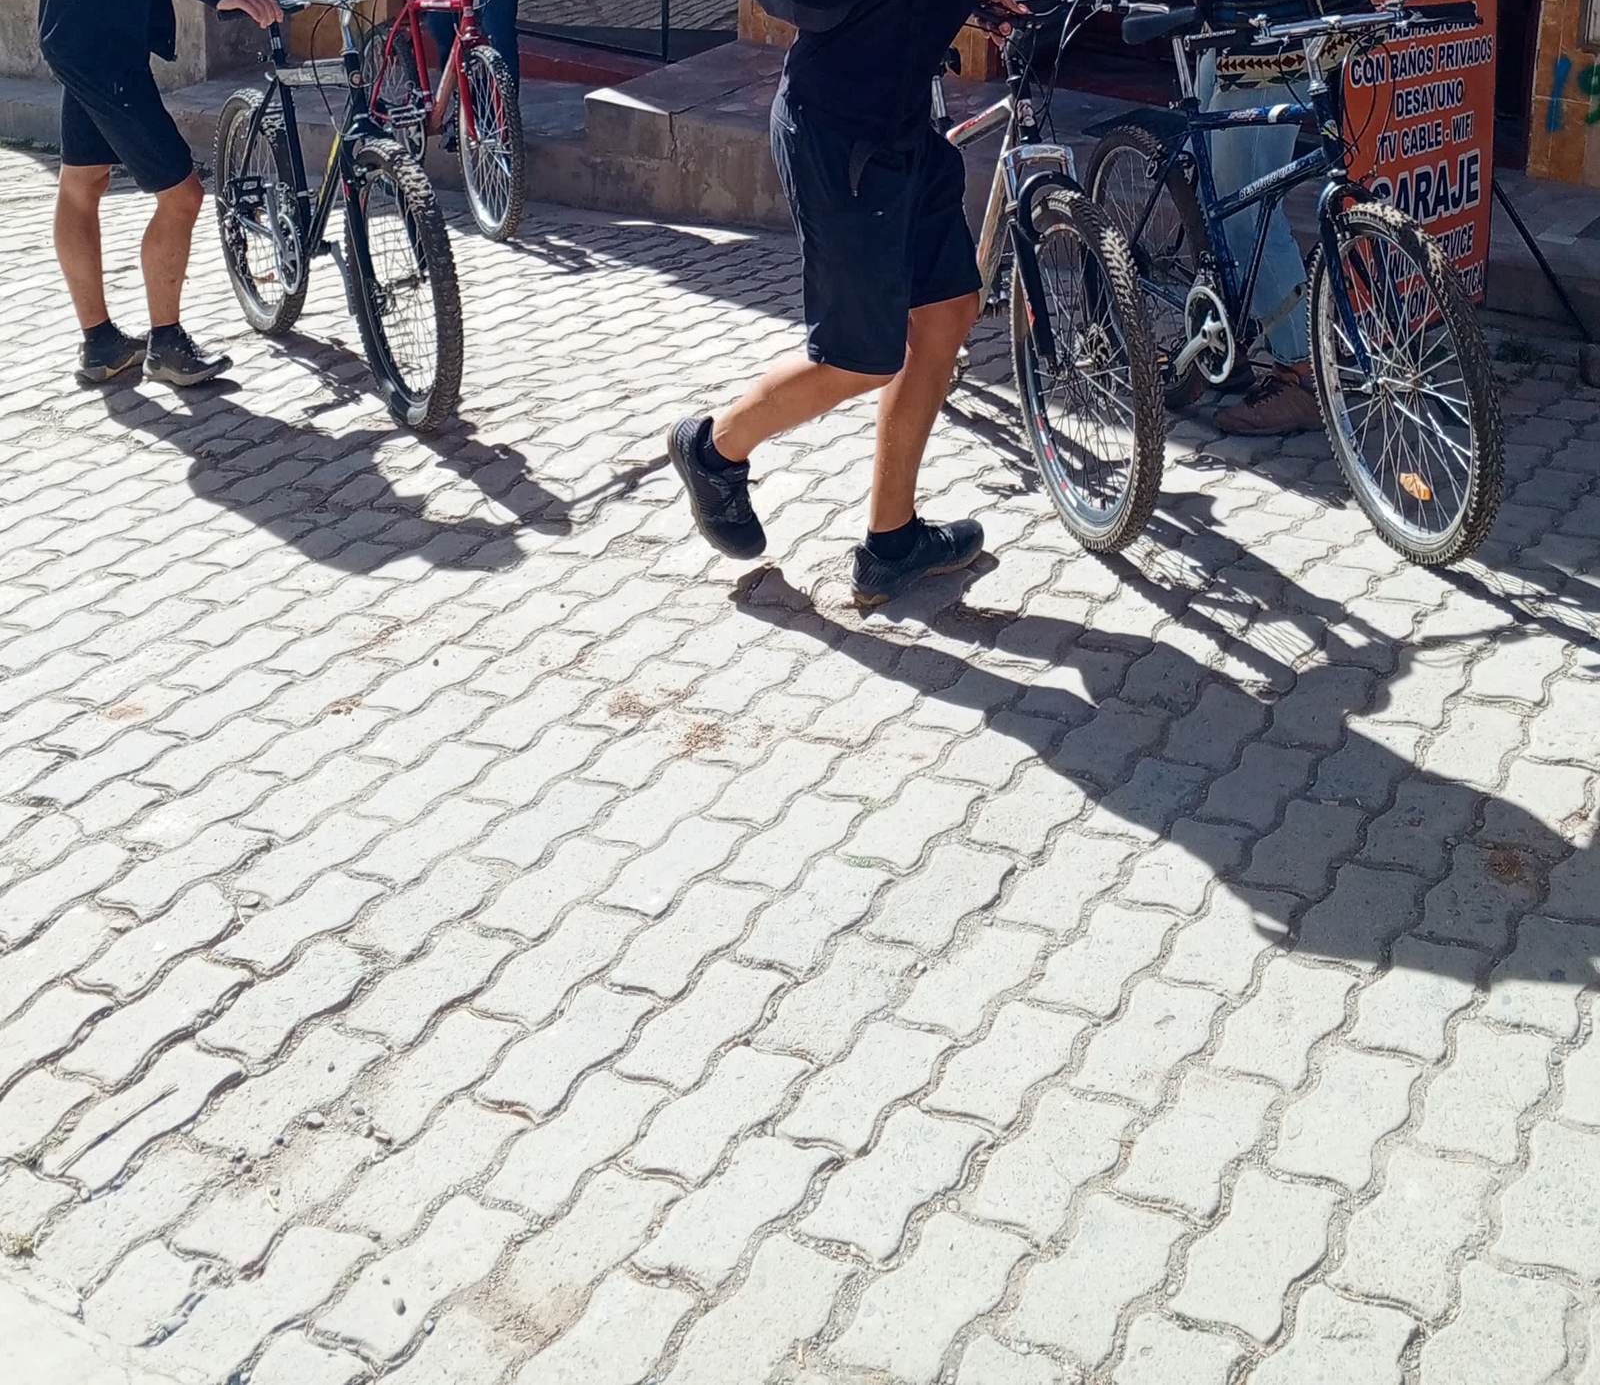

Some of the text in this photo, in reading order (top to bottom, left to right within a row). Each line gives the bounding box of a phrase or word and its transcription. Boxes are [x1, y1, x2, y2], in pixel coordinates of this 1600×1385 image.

[1350, 35, 1493, 88] CON BAÑOS PRIVADOS
[1394, 77, 1465, 121] DESAYUNO
[1377, 129, 1399, 165] TV
[1400, 120, 1443, 158] CABLE
[1451, 111, 1475, 145] WIFI
